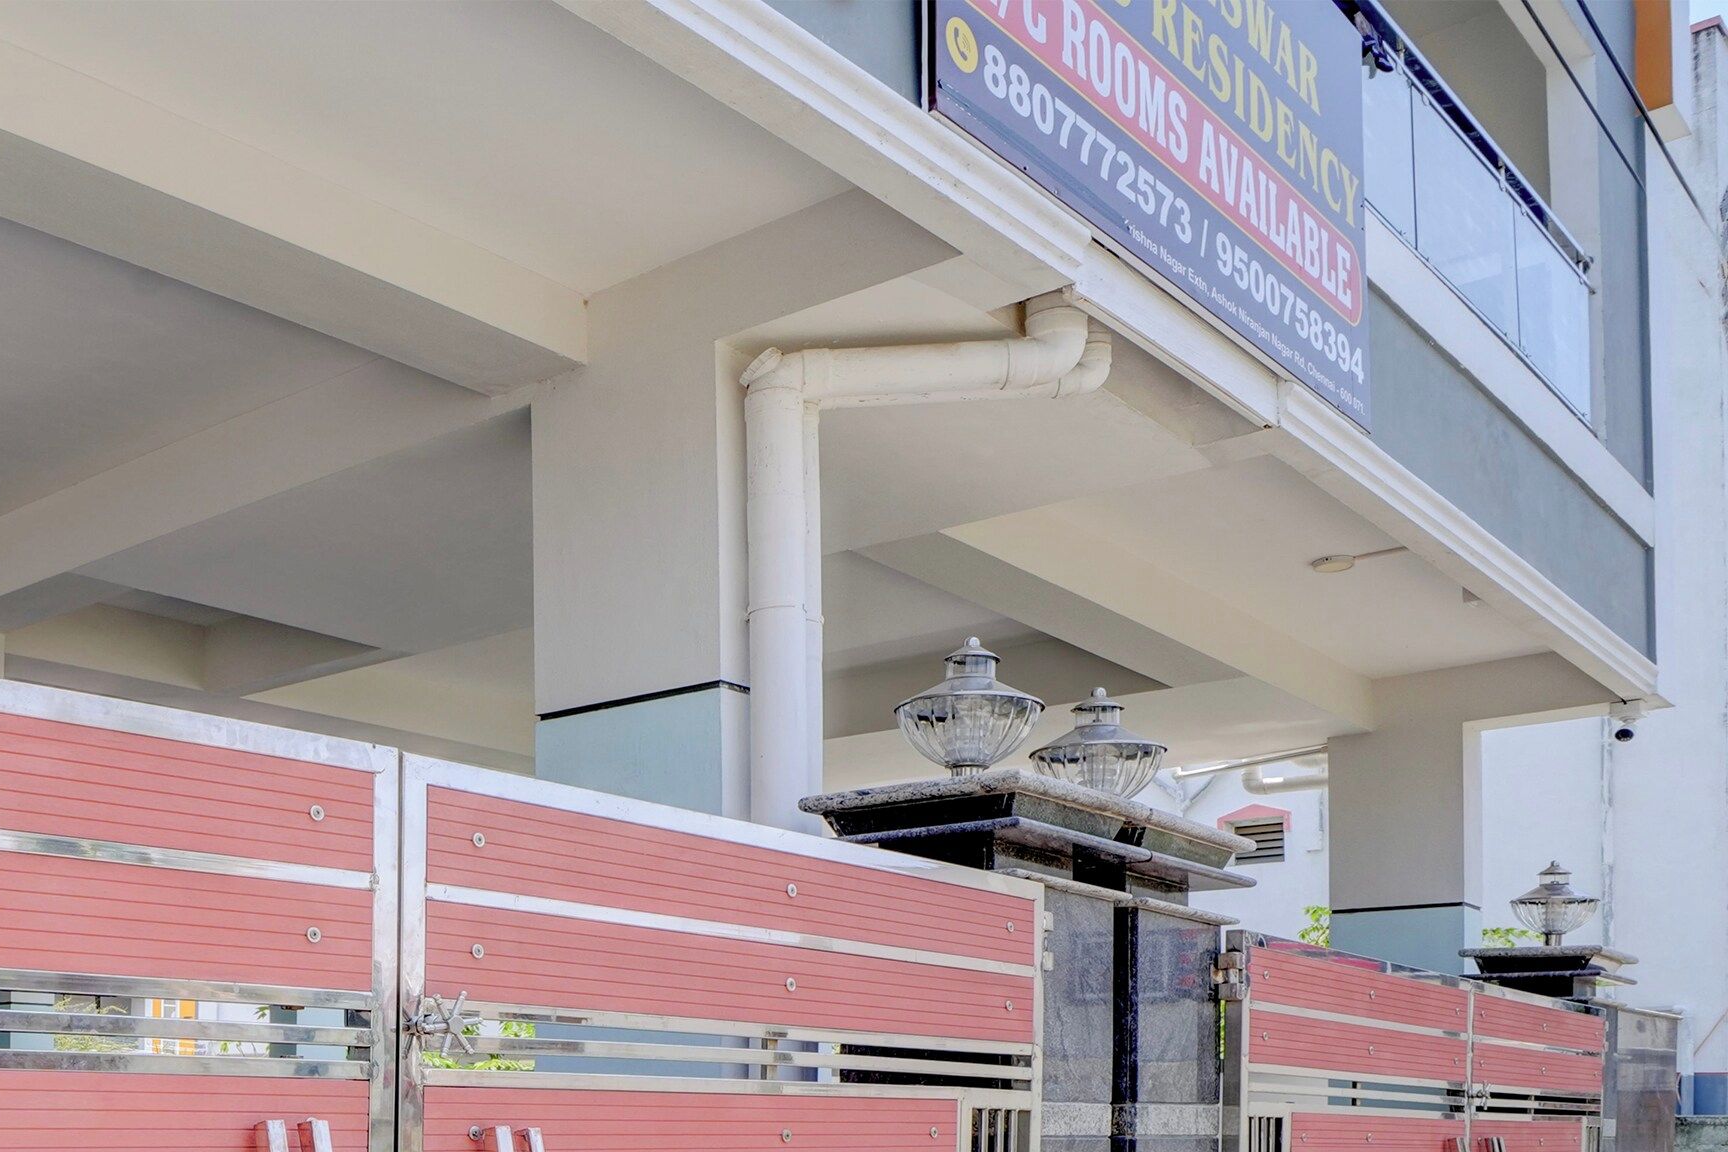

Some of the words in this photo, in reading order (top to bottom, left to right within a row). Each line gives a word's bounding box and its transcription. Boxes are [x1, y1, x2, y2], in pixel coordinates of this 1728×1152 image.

[983, 44, 1192, 244] 8807772573
[1200, 219, 1208, 258] /
[1216, 232, 1365, 385] 9500758394
[1062, 0, 1189, 164] ROOMS
[1199, 119, 1353, 310] AVAILABLE
[1152, 0, 1359, 228] RESIDENCY
[1123, 217, 1158, 255] rishna
[1160, 245, 1186, 275] Nagar
[1211, 286, 1237, 316] Ashok
[1272, 333, 1293, 359] Nagar
